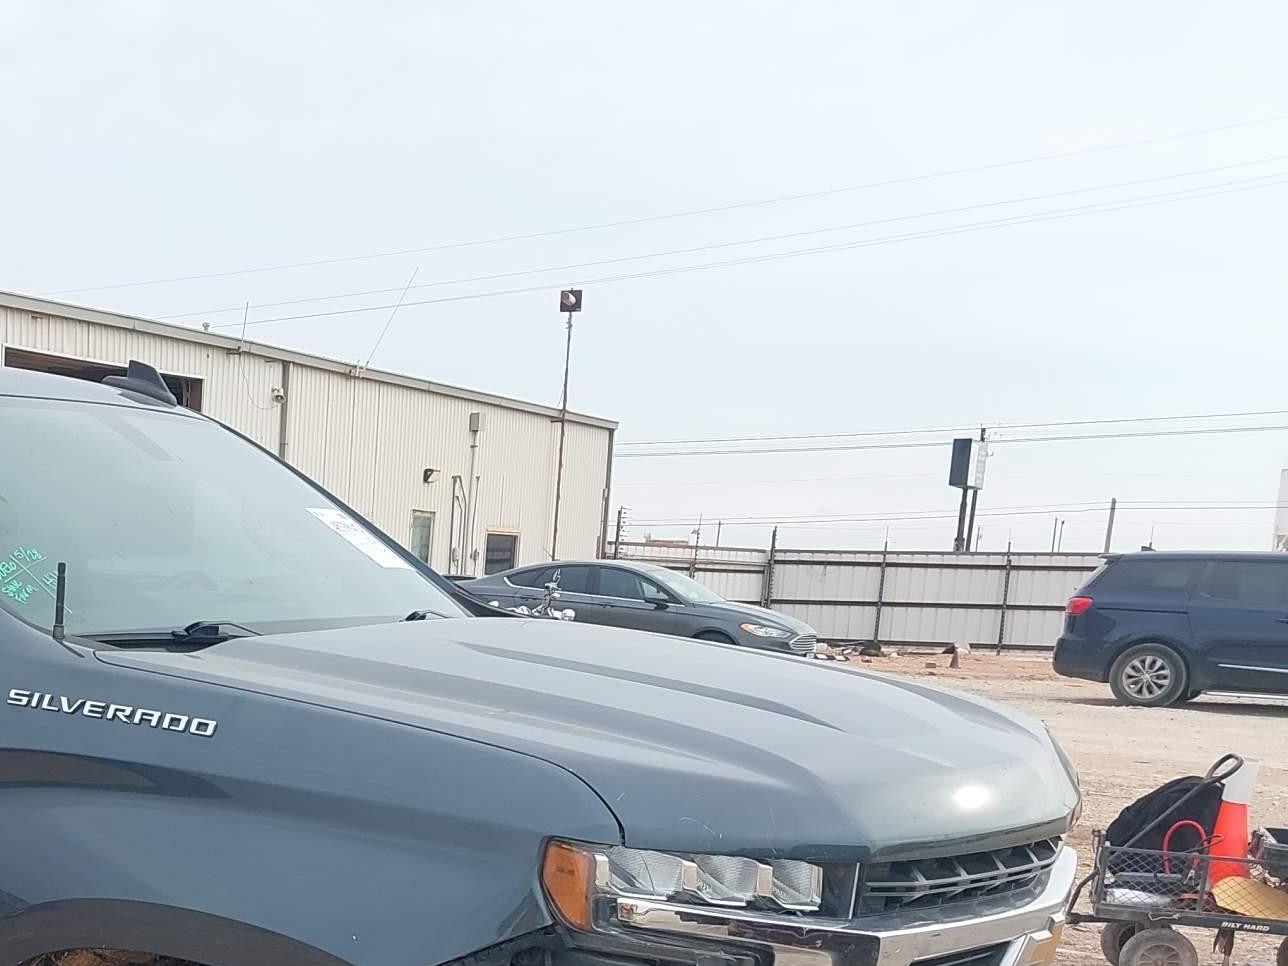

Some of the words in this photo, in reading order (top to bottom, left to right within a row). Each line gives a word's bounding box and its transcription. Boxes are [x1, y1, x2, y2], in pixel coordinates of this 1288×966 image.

[7, 688, 218, 737] SILVERADO
[1221, 921, 1243, 929] BILT
[1243, 924, 1270, 932] HARD
